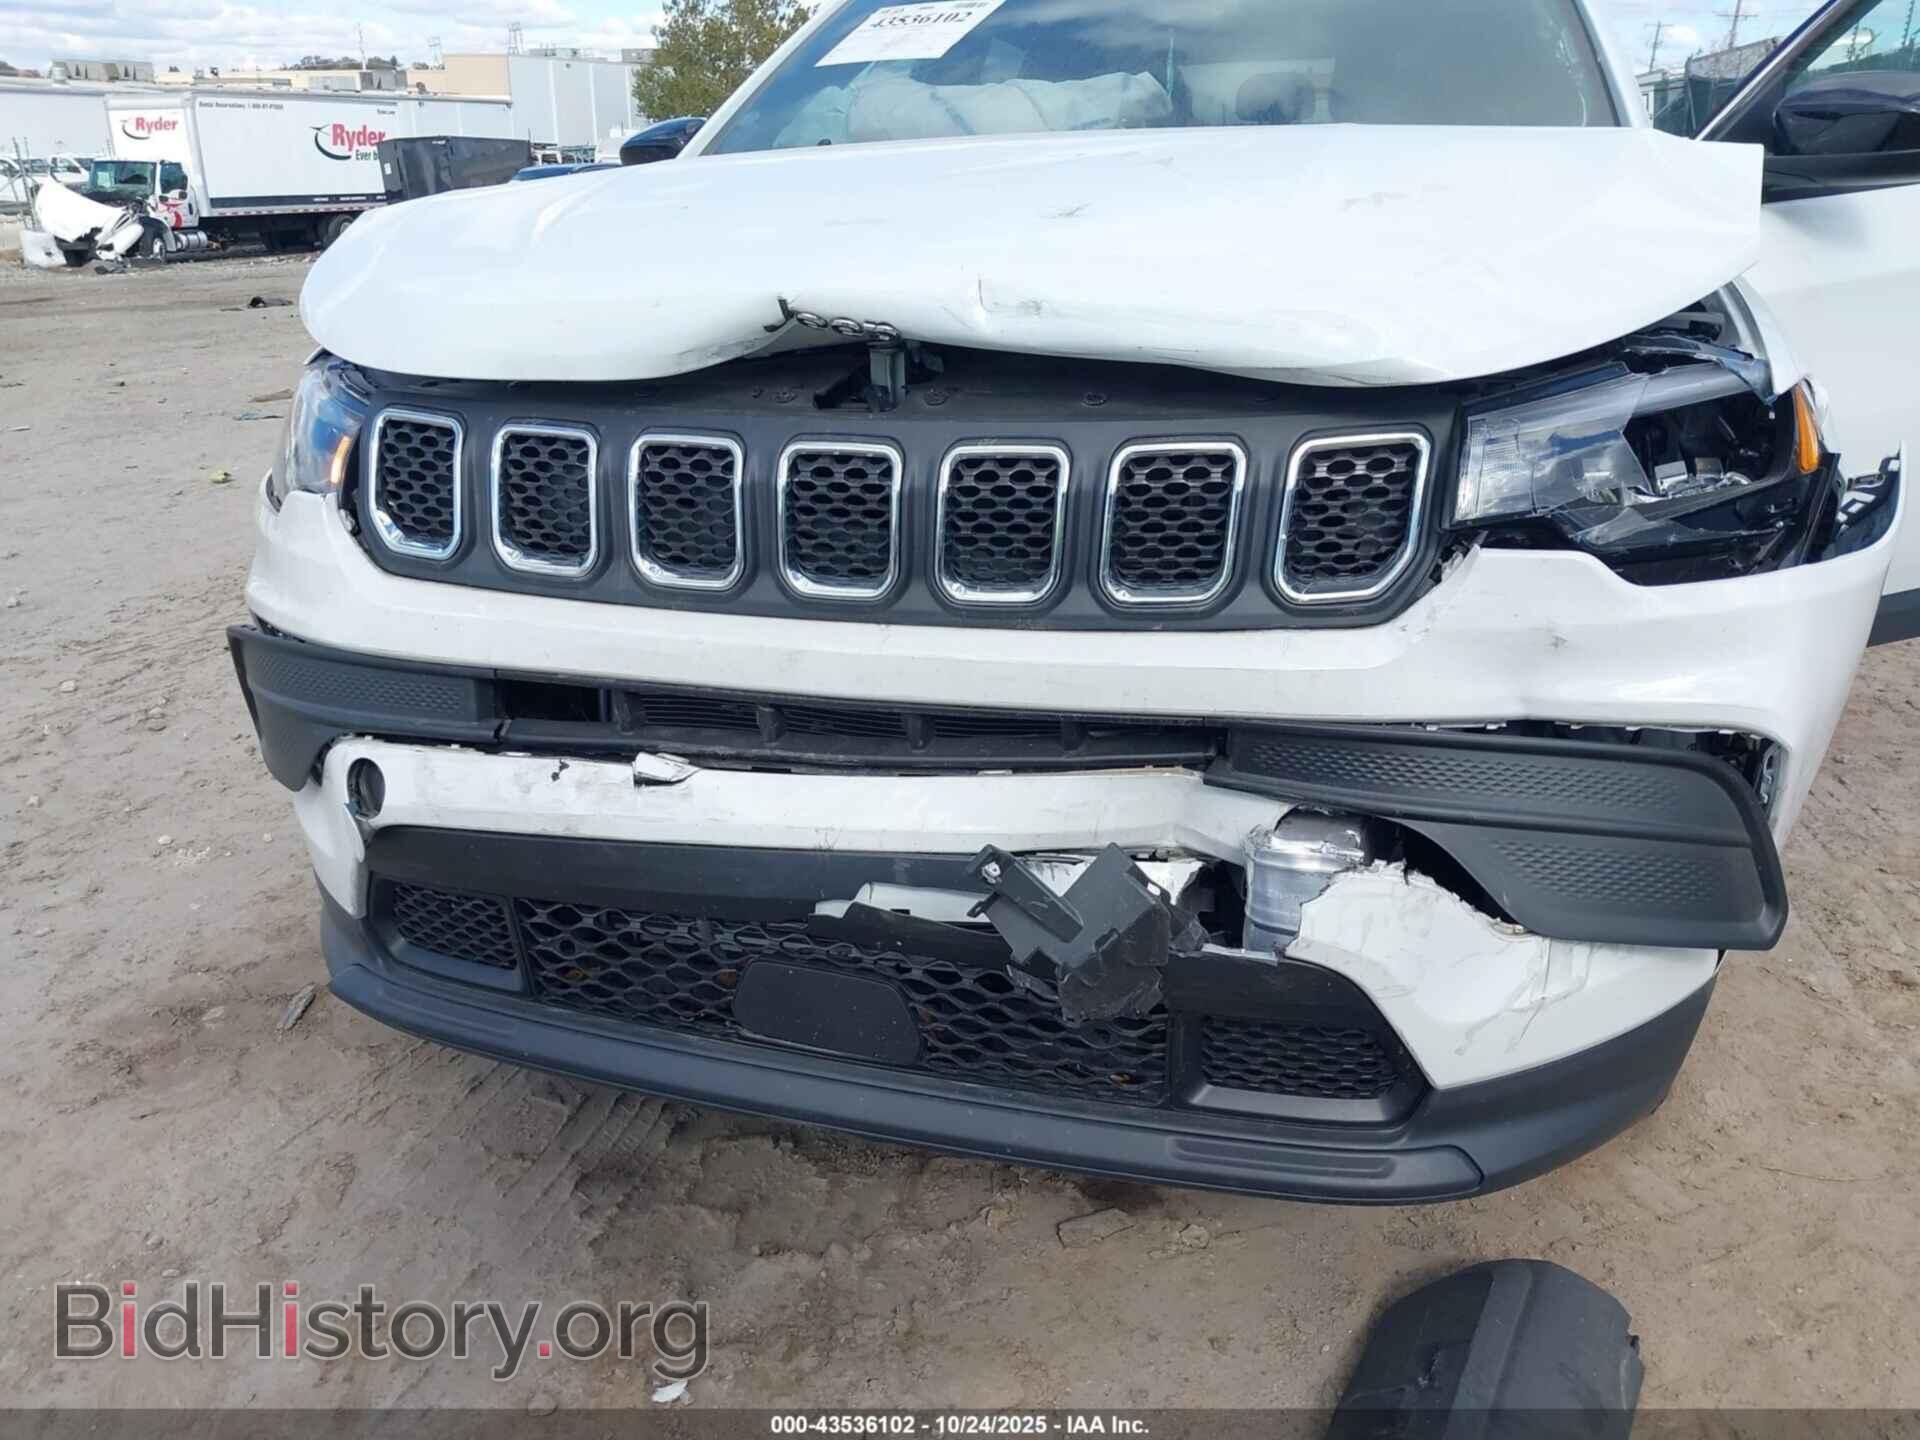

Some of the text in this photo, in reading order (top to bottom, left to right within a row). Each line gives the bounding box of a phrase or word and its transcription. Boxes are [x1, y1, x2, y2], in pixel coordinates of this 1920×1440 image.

[872, 11, 972, 28] 43536102
[135, 116, 178, 134] Ryder
[332, 124, 385, 151] Ryder
[355, 149, 371, 160] Ever
